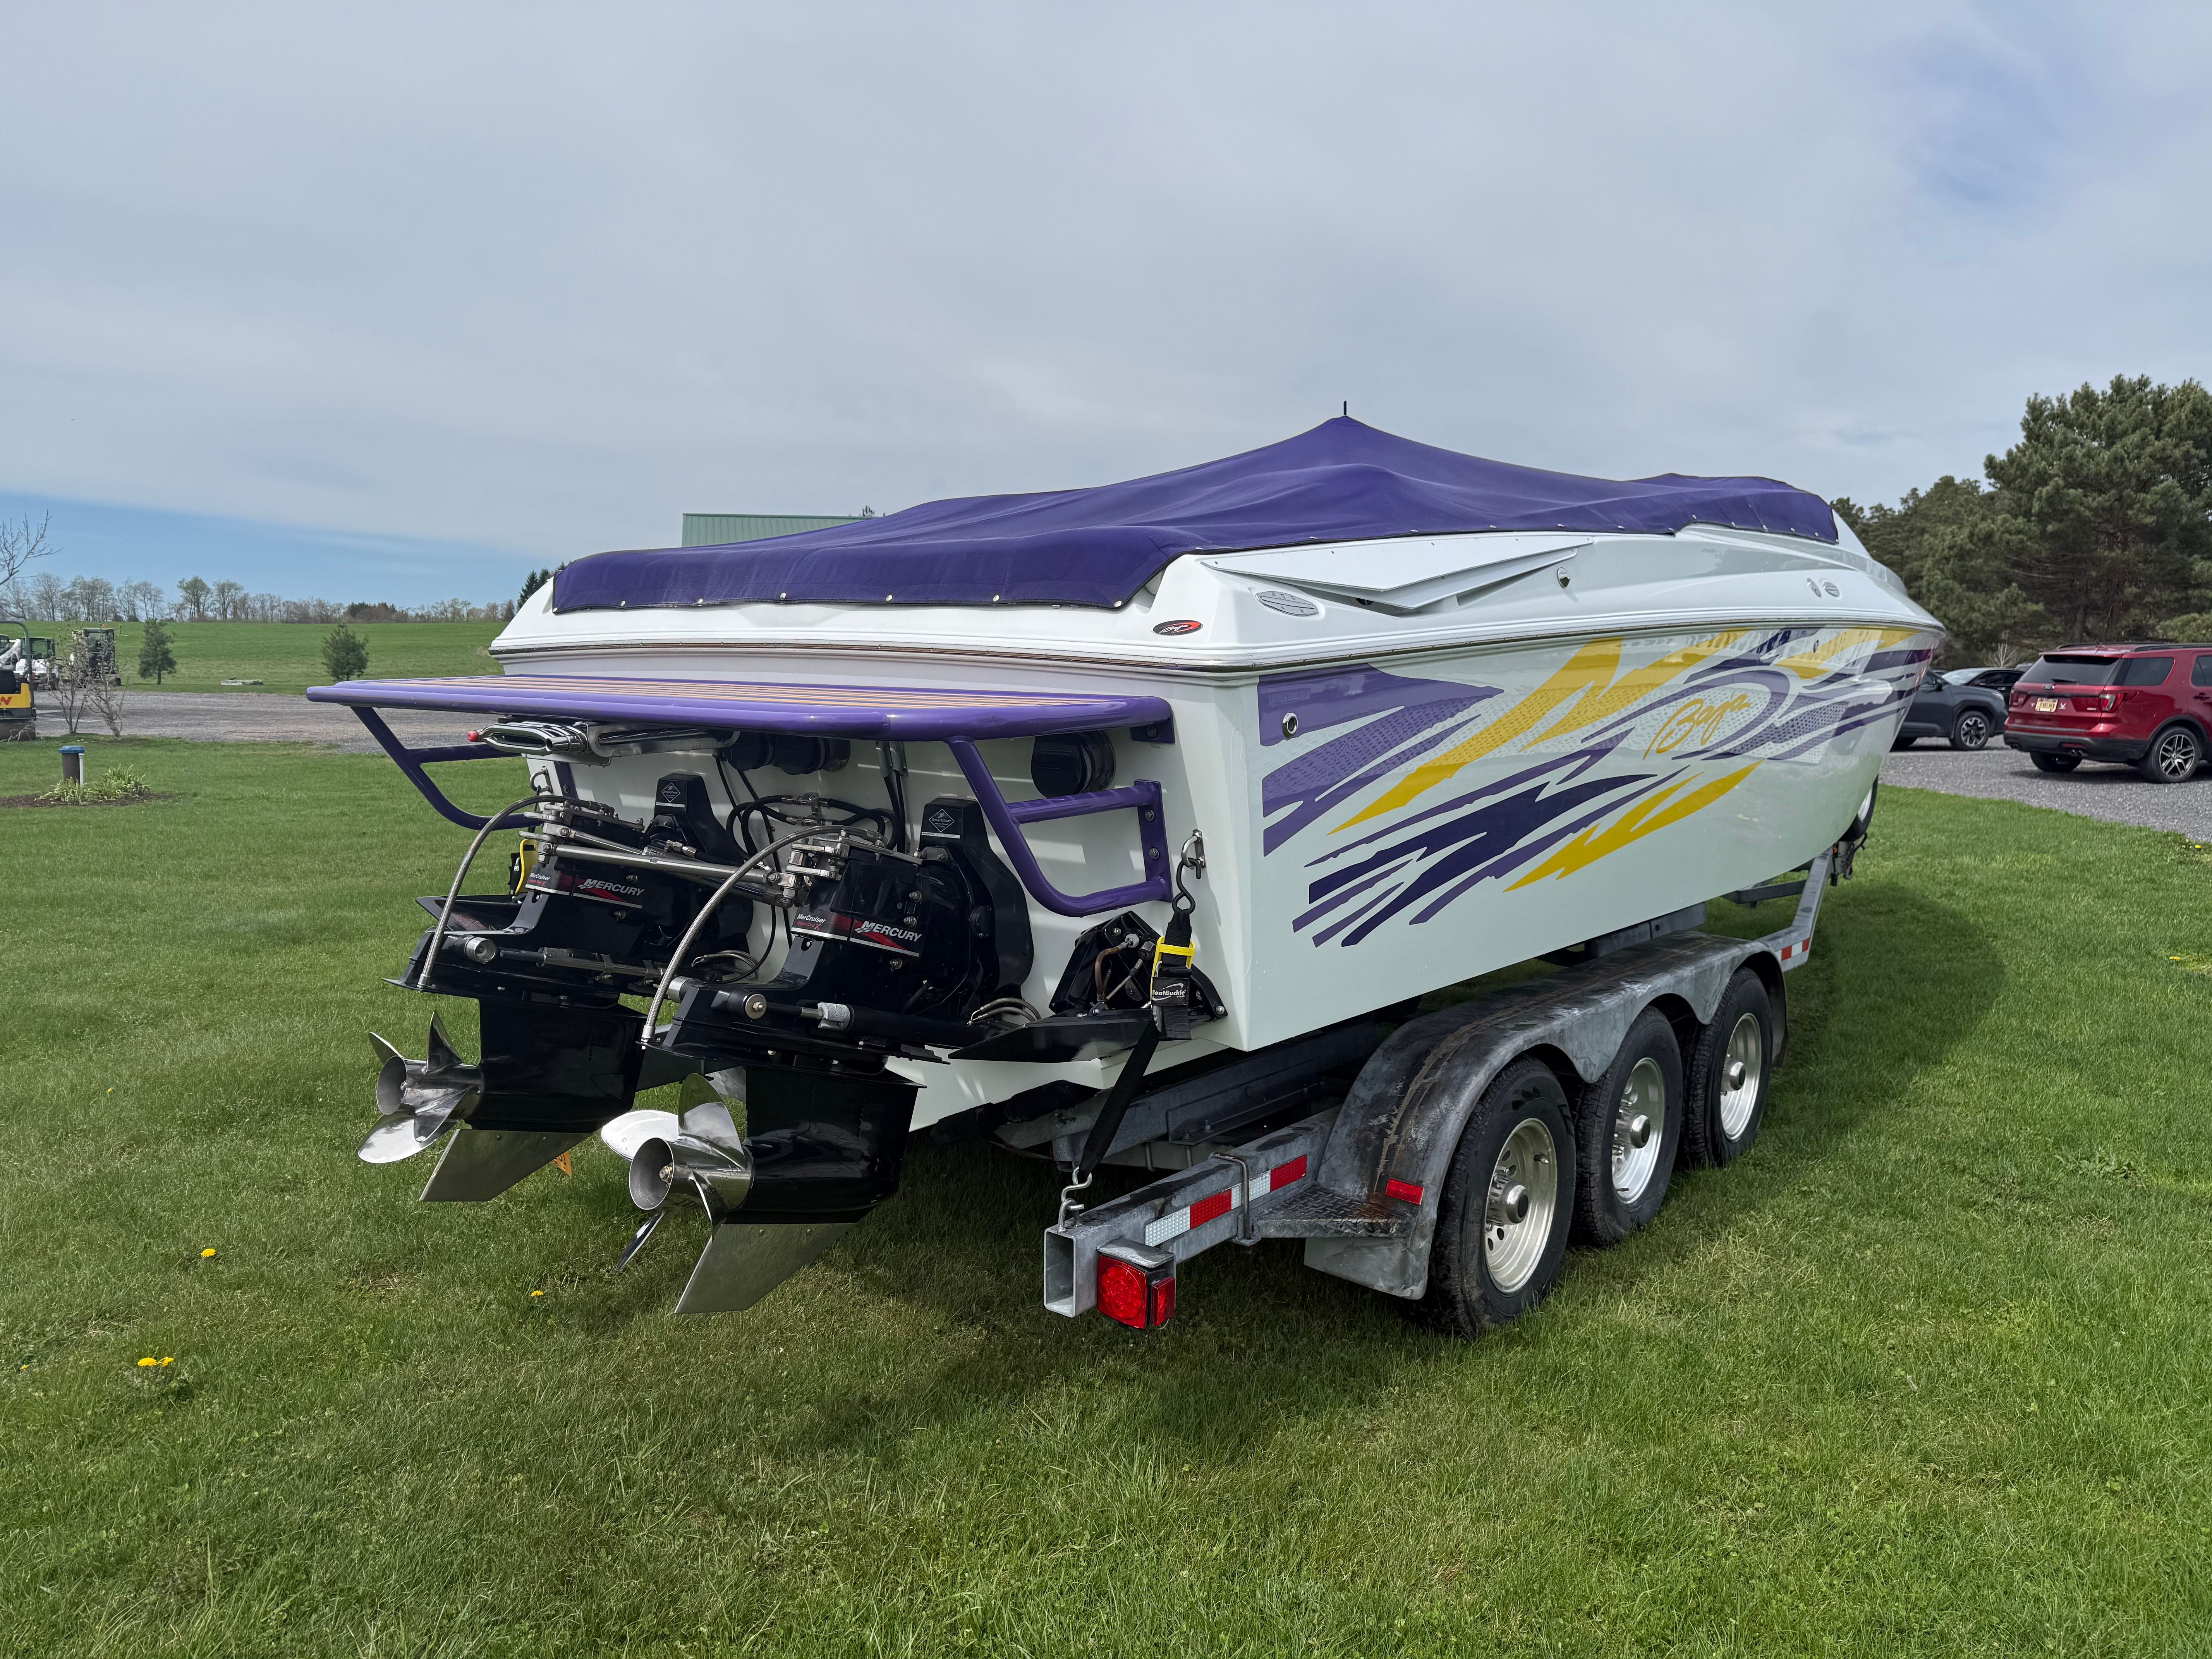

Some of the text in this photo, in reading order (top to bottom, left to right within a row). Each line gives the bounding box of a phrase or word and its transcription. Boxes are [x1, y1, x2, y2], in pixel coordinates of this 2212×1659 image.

[1643, 691, 1752, 760] Baja
[577, 878, 645, 896] MERCURY
[797, 914, 826, 923] MerCruiser
[854, 921, 922, 942] MERCURY
